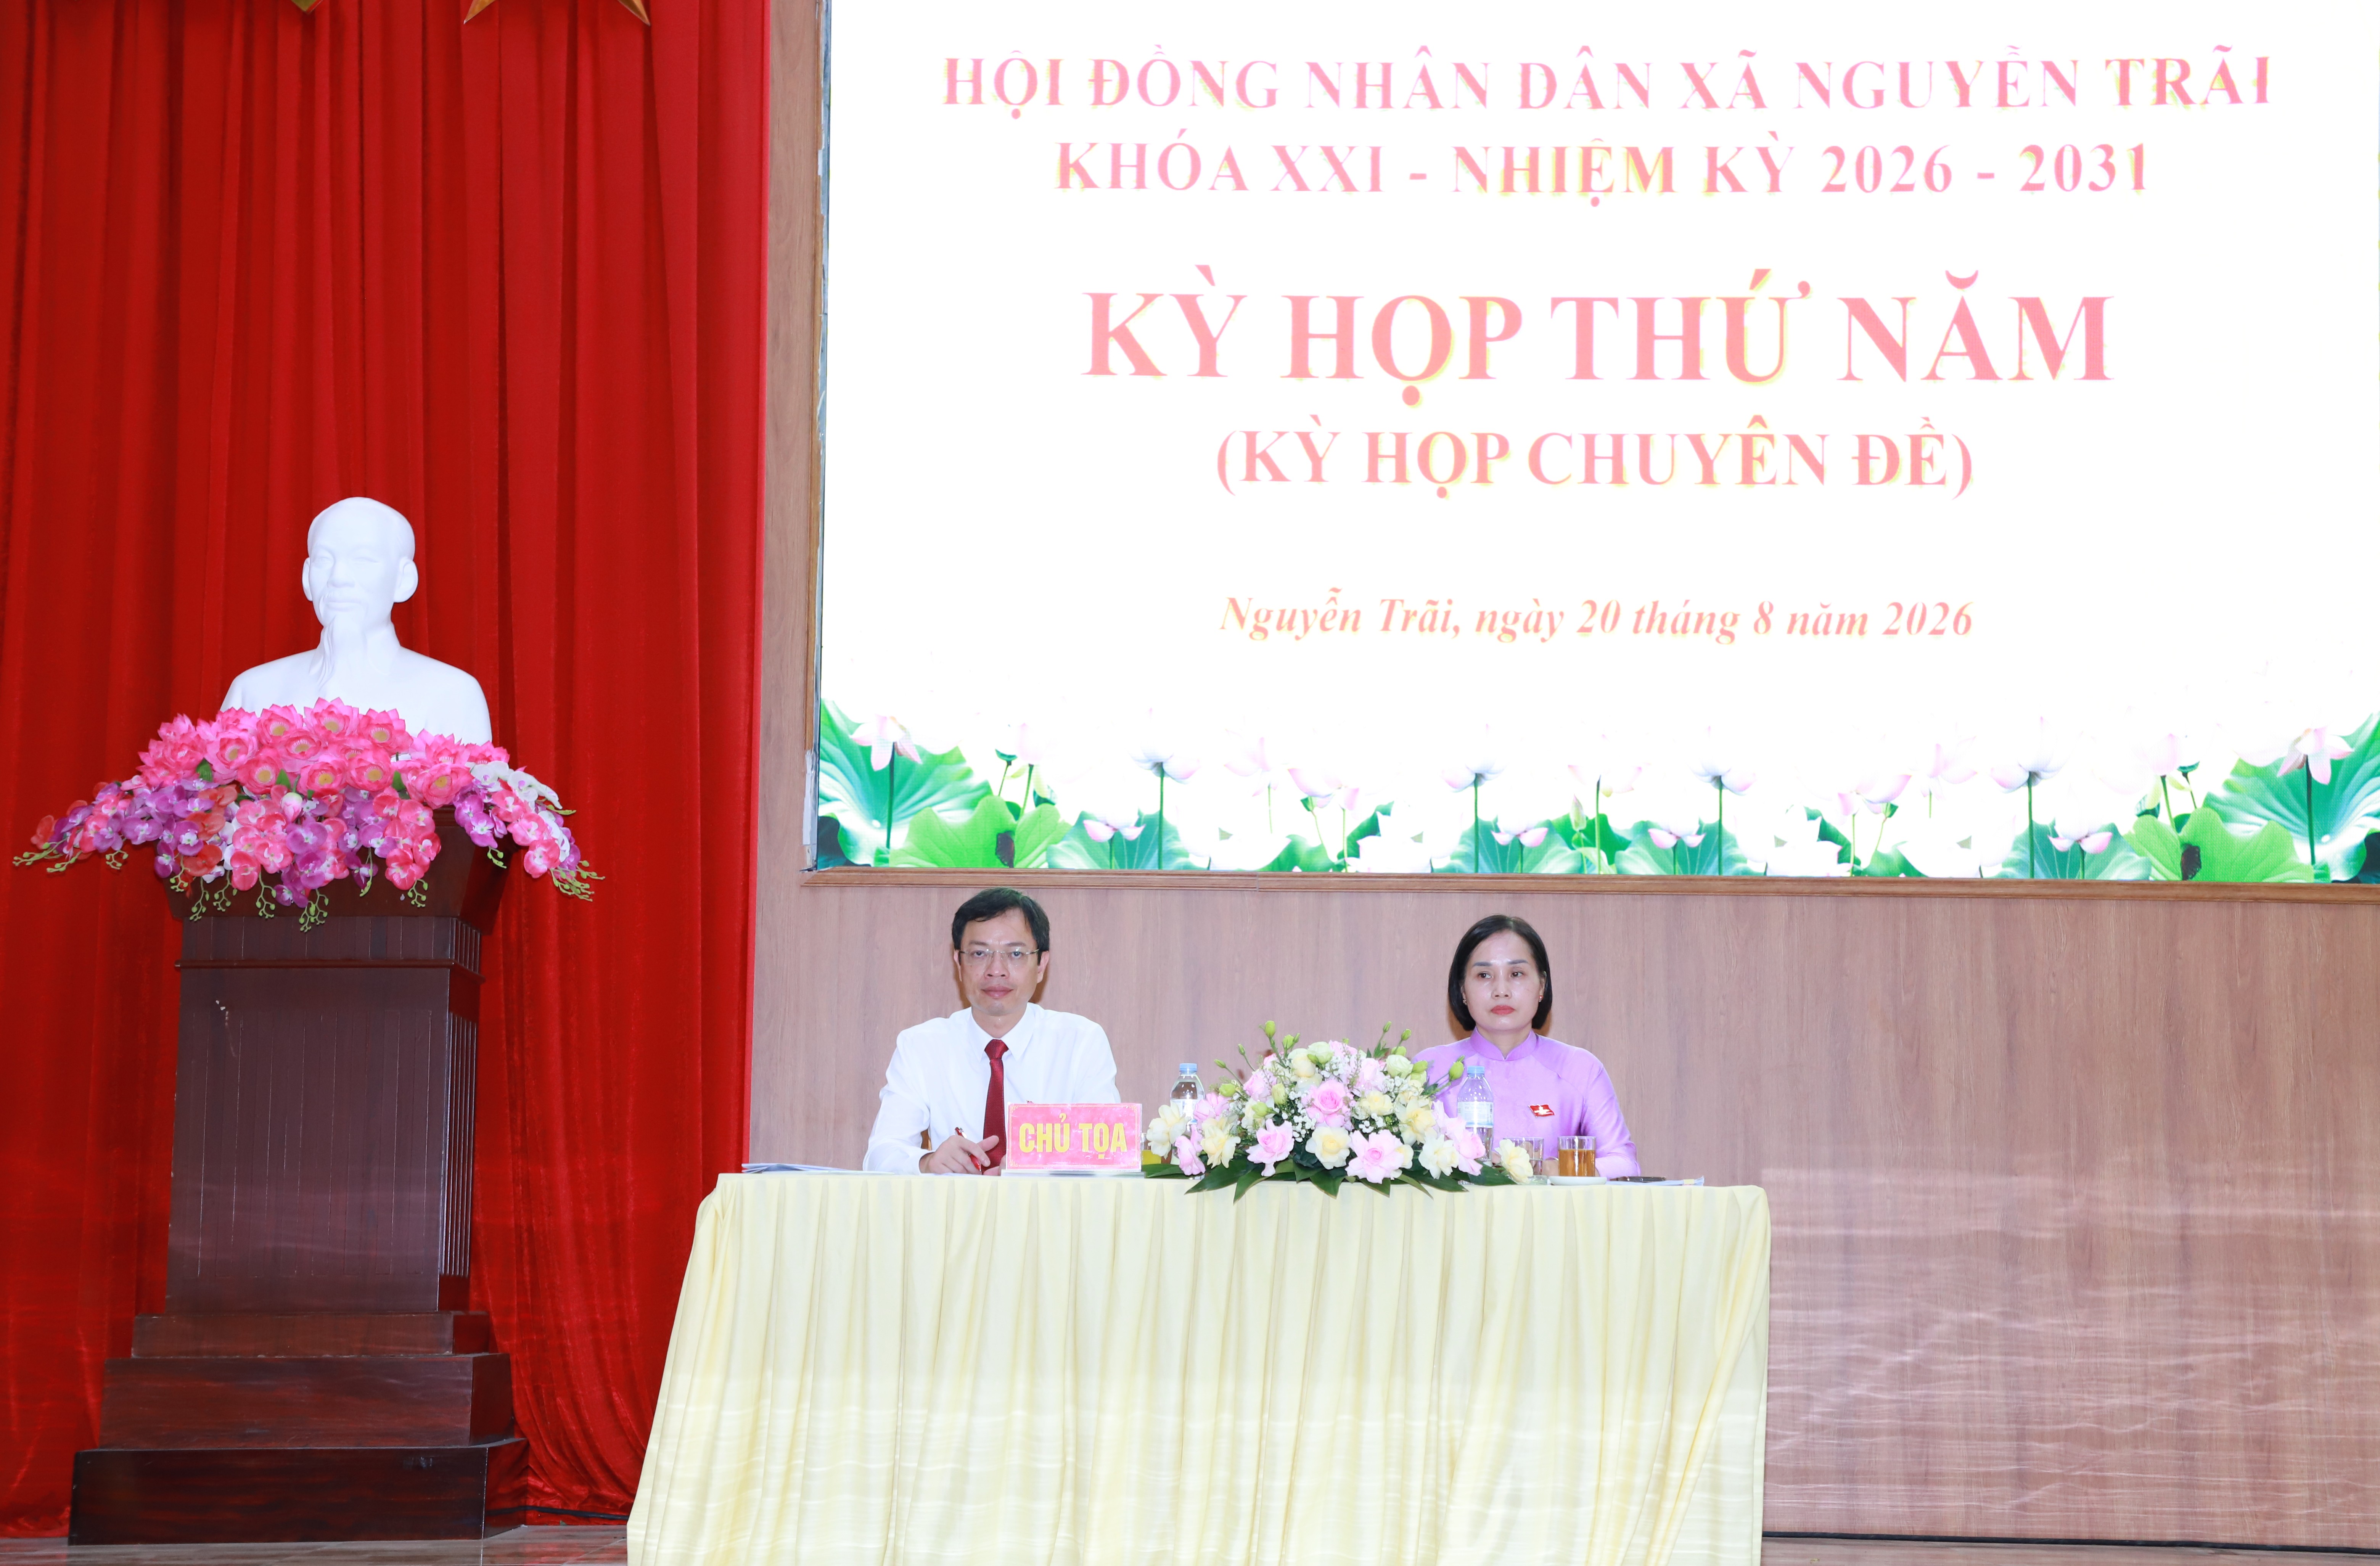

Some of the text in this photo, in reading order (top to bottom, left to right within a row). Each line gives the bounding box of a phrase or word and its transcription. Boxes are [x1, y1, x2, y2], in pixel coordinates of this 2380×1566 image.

[942, 44, 2271, 119] HỘI ĐỒNG NHÂN DÂN XÃ NGUYỄN TRÃI
[1055, 128, 1250, 191] KHÓA
[1269, 145, 1384, 193] XXI
[1452, 138, 1677, 207] NHIỆM
[1700, 131, 1795, 195] KỲ
[1821, 145, 1952, 193] 2026
[2018, 143, 2146, 194] 2031
[1082, 264, 2114, 407] KỲ HỌP THỨ NĂM
[1217, 414, 1972, 500] (KỲ HỌP CHUYÊN ĐỀ)
[1220, 587, 1973, 645] Nguyễn Trãi, ngày 20 tháng 8 năm 2026
[1019, 1113, 1127, 1159] CHỦ TỌA
